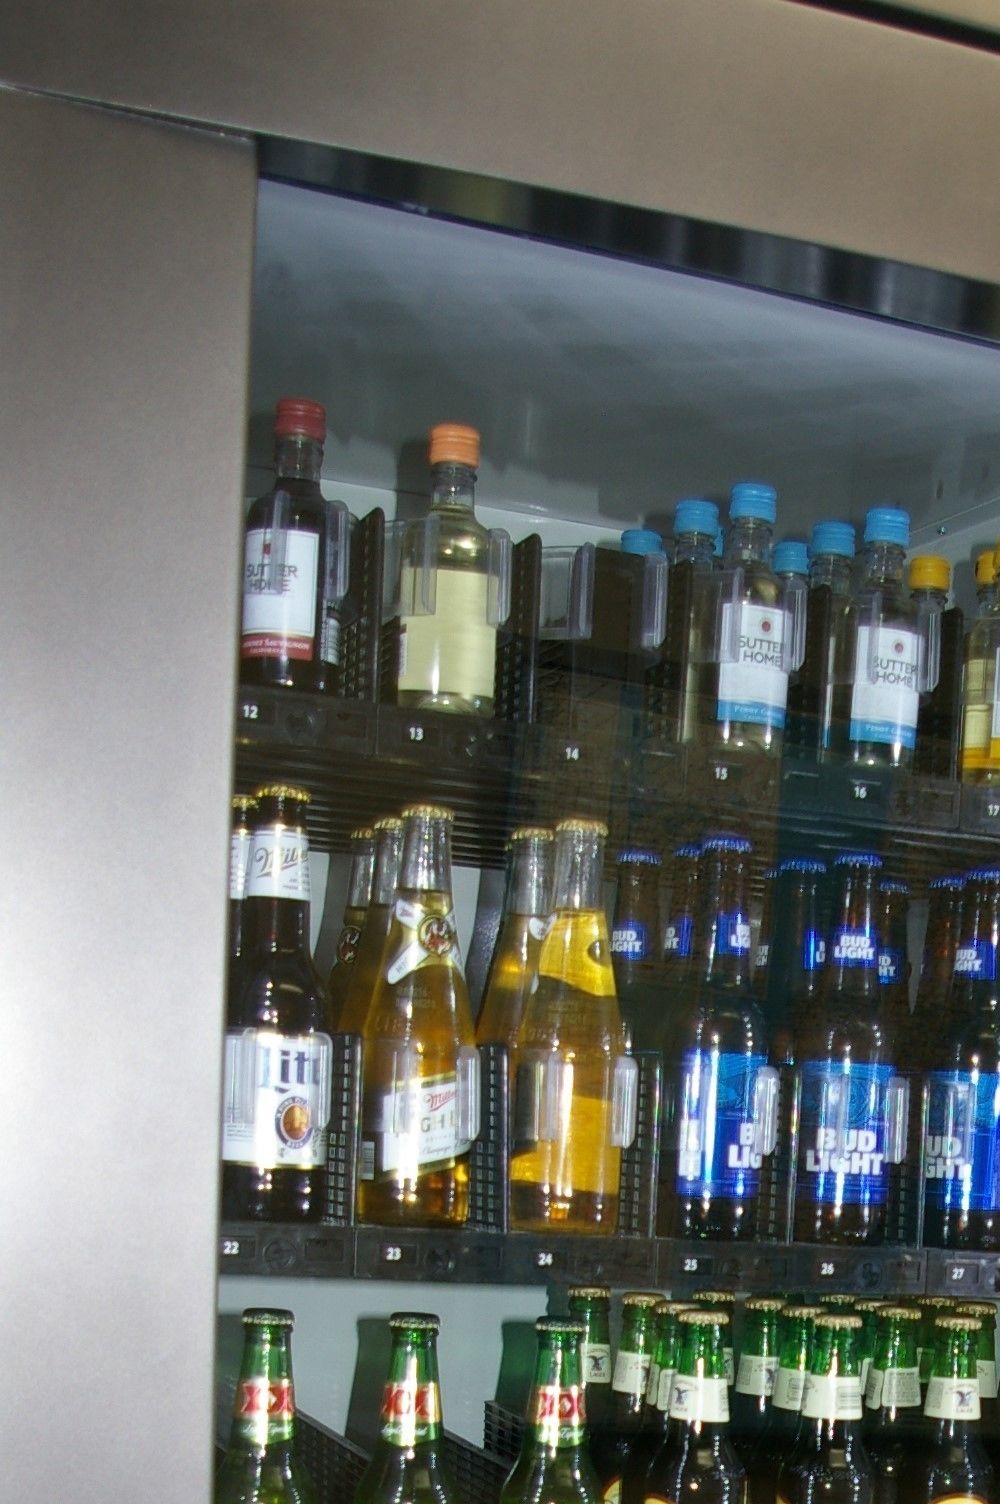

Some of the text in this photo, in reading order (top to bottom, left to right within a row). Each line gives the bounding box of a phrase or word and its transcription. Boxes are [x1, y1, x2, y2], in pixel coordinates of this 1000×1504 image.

[243, 704, 258, 719] 12
[409, 727, 424, 741] 13
[565, 747, 579, 761] 14
[715, 766, 728, 781] 15
[854, 785, 867, 799] 16
[988, 803, 1000, 817] 17
[839, 935, 871, 948] BUD
[833, 945, 875, 960] LIGHT
[816, 1127, 877, 1152] BUD
[926, 1134, 963, 1157] UD
[805, 1149, 884, 1176] LIGHT
[223, 1240, 240, 1255] 22
[386, 1246, 402, 1261] 23
[537, 1252, 553, 1266] 24
[683, 1258, 698, 1271] 25
[820, 1262, 835, 1275] 26
[951, 1267, 965, 1280] 27
